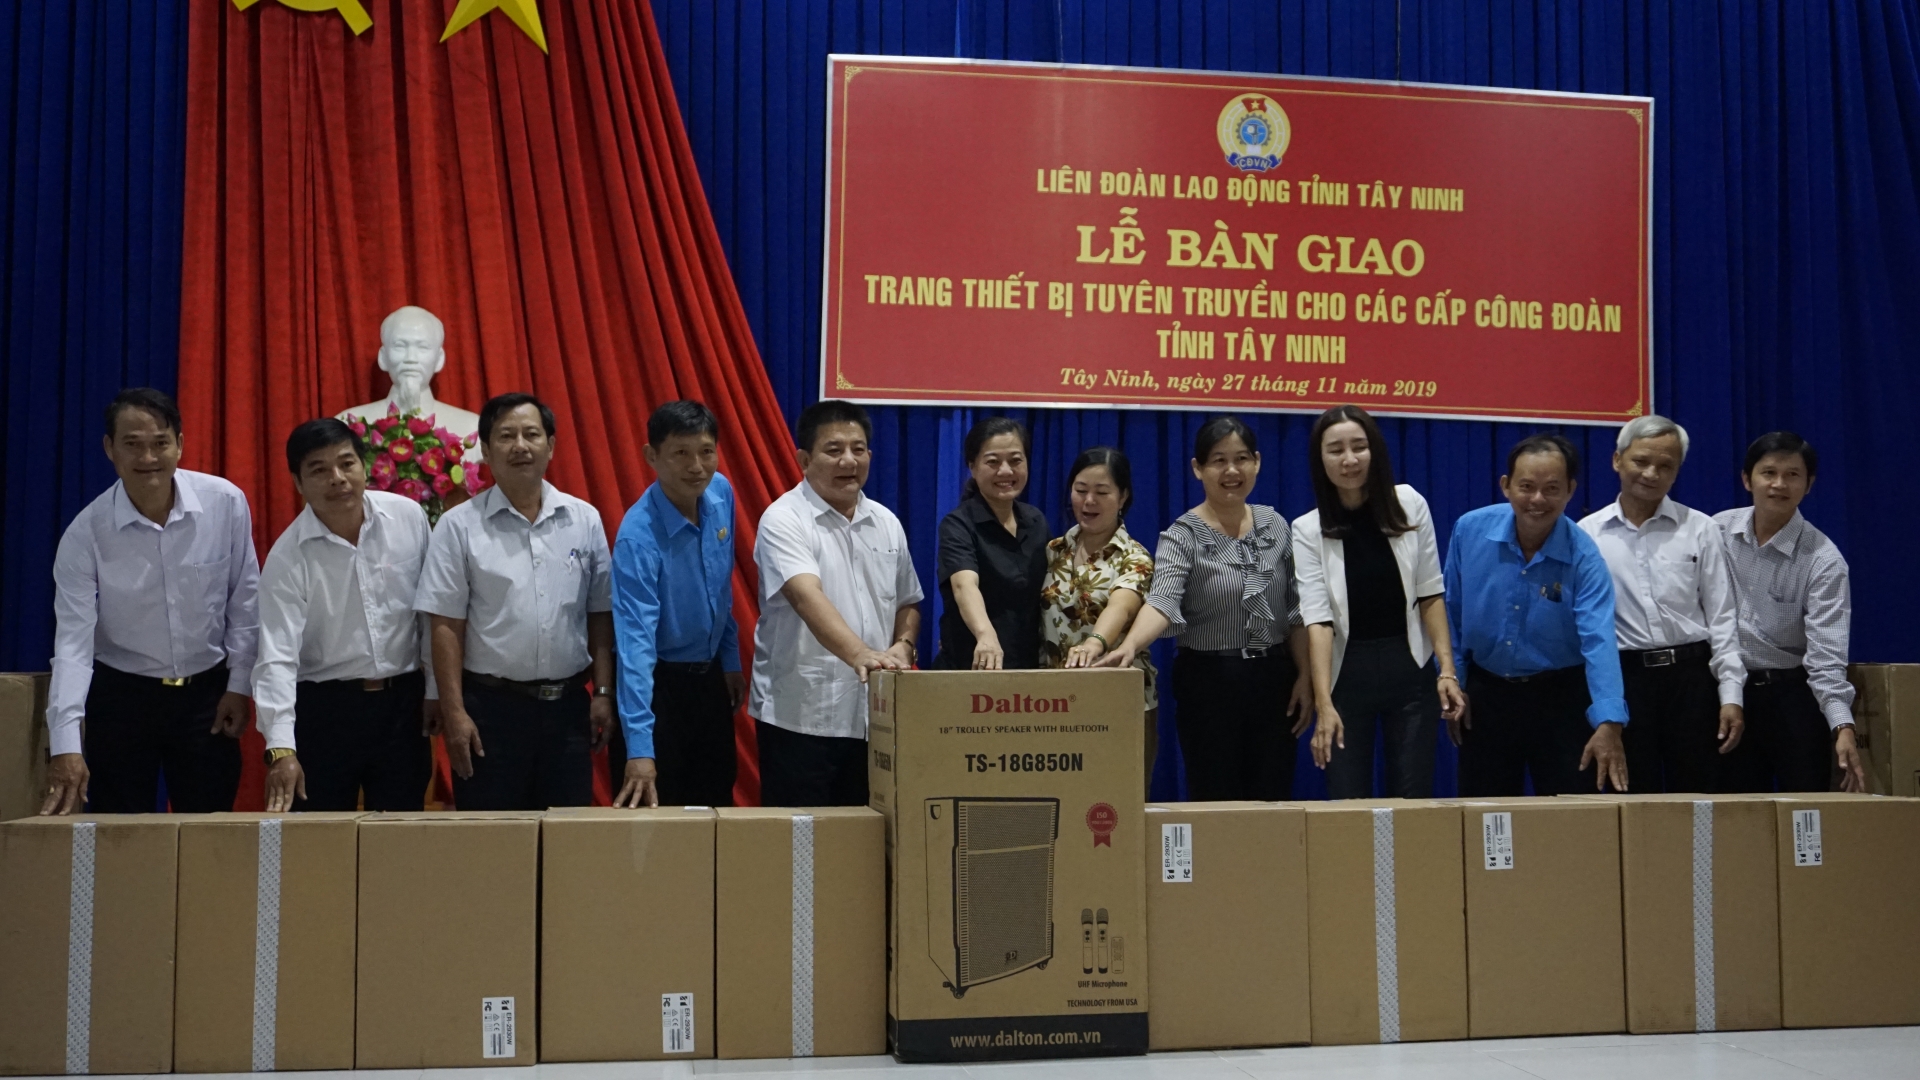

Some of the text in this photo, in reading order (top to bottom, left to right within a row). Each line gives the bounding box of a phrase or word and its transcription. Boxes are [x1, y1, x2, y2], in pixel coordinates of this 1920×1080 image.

[1240, 158, 1268, 169] CĐVN
[1037, 165, 1464, 212] LIÊN ĐOÀN LAO ĐỘNG TỈNH TÂY NINH
[1076, 206, 1425, 277] LỄ BÀN GIAO
[864, 271, 1621, 332] TRANG THIẾT BỊ TUYÊN TRUYỀN CHO CÁC CẤP CÔNG ĐOÀN
[1156, 321, 1346, 364] TỈNH TÂY NINH
[1060, 368, 1437, 397] Tây Ninh, ngày 27 tháng 11 năm 2019
[956, 726, 992, 734] TROLLEY
[994, 725, 1031, 734] SPEAKER
[1034, 725, 1057, 733] WITH
[1060, 724, 1109, 733] BLUETOOTH
[965, 752, 1083, 773] TS-18G850N
[1096, 811, 1108, 819] ISO
[1077, 979, 1128, 989] UHF Microphone
[1067, 998, 1138, 1008] TECHNOLOGY FROM USA
[950, 1029, 1101, 1048] www.dalton.com.vn
